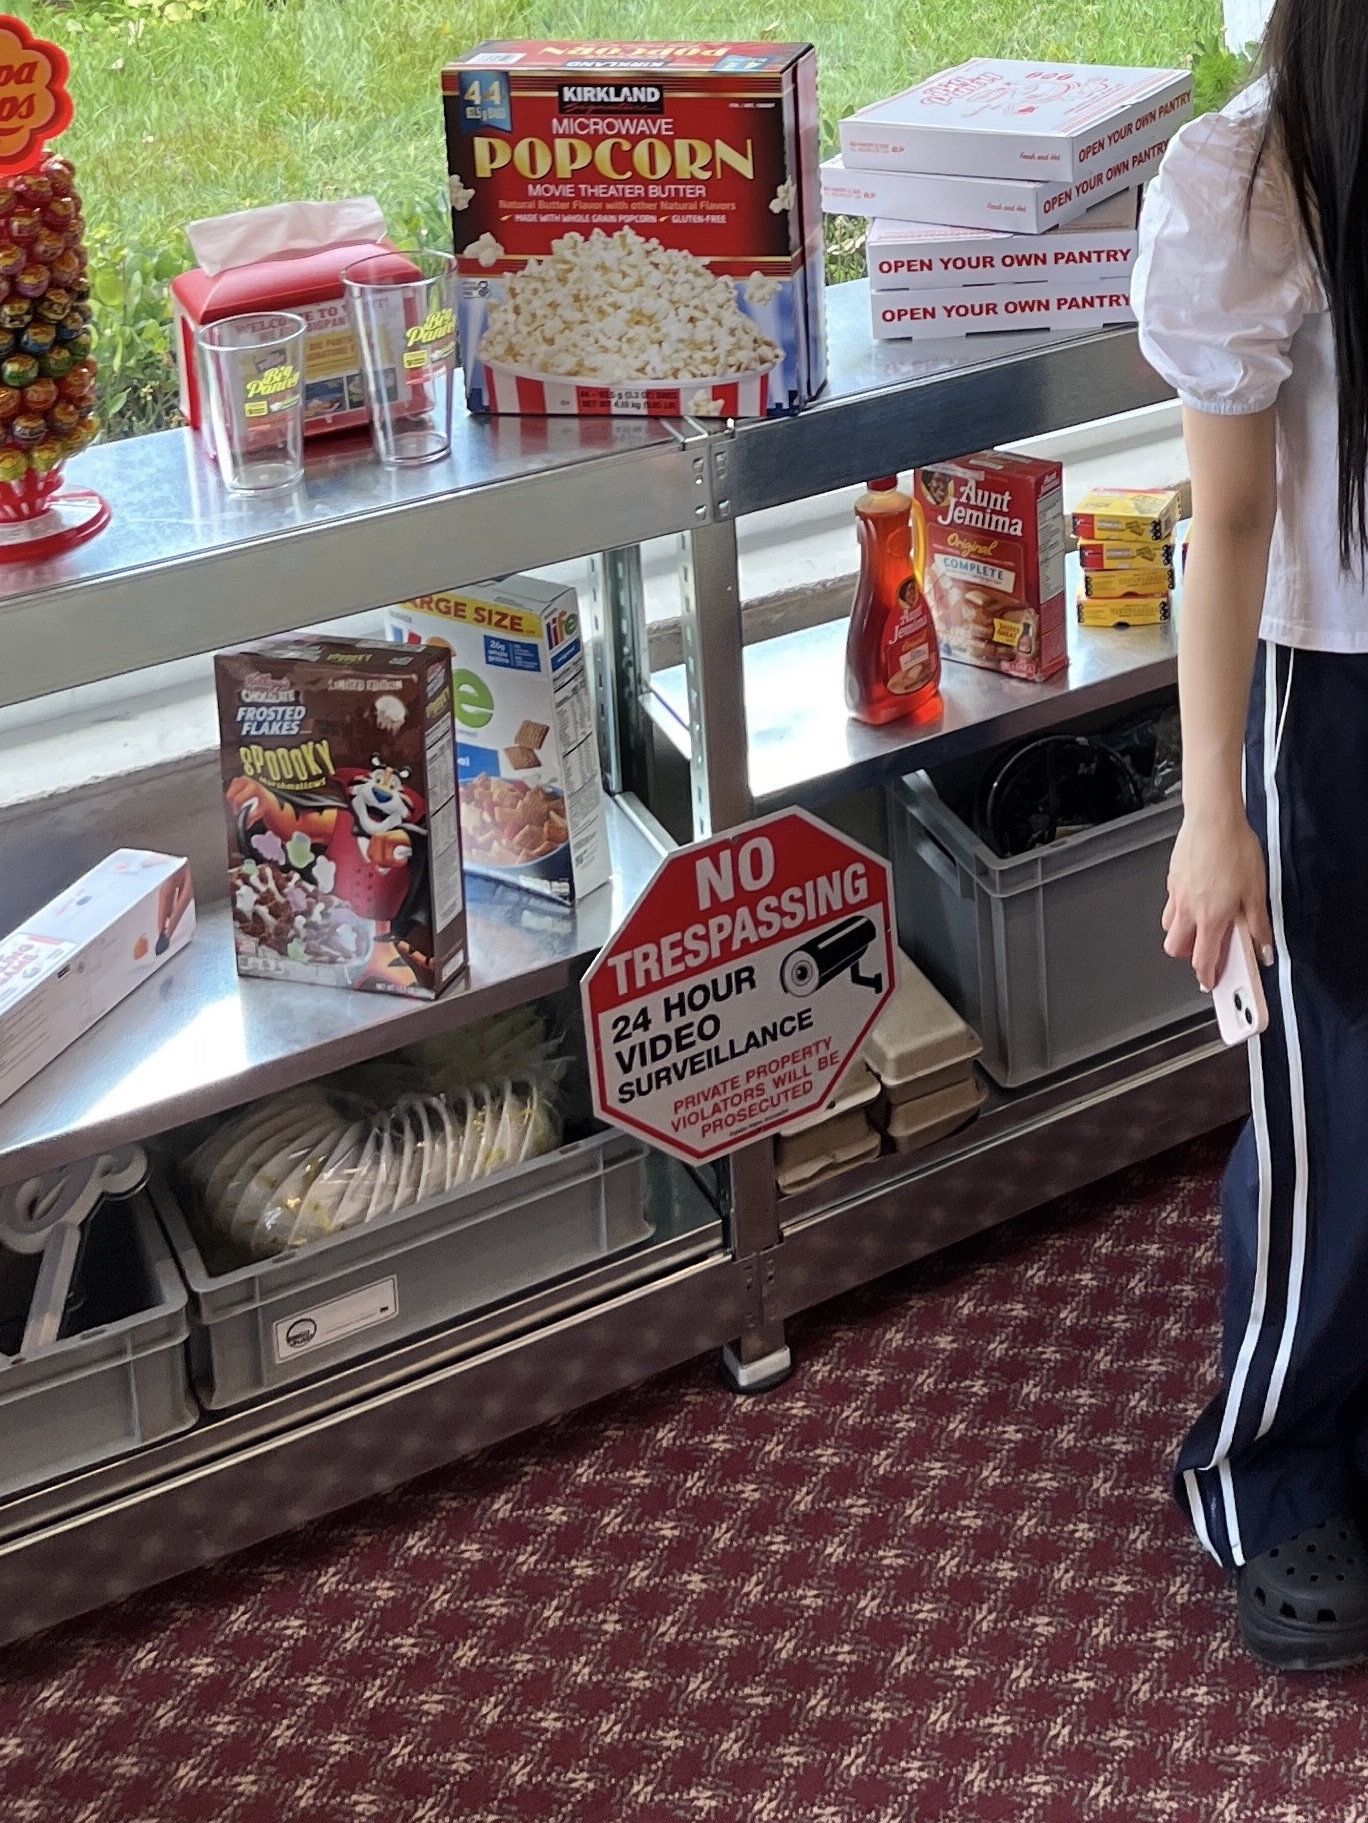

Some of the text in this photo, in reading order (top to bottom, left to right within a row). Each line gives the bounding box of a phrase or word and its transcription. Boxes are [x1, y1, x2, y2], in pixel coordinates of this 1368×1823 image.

[563, 86, 661, 103] KIRKLAND
[552, 118, 674, 136] MICROWAVE
[1078, 89, 1193, 164] OPEN YOUR OWN PANTRY
[474, 136, 754, 181] POPCORN
[527, 184, 706, 198] MOVIE THEATER BUTTER
[1043, 138, 1170, 215] OPEN YOUR OWN PANTRY
[498, 199, 736, 211] Natural Butter Flavor with other Natural Flavors
[539, 213, 560, 223] WITH
[617, 214, 657, 223] POPCORN
[671, 214, 727, 224] GLUTEN-FREE
[878, 248, 1132, 275] OPEN YOUR OWN PANTRY
[318, 306, 338, 319] TO
[423, 307, 453, 329] Big
[881, 293, 1131, 323] OPEN YOUR OWN PANTRY
[262, 365, 294, 385] Big
[959, 479, 1013, 513] Aunt
[937, 496, 1023, 538] Jemima
[947, 532, 999, 558] Original
[943, 557, 1004, 581] COMPLETE
[404, 596, 524, 633] ARGE SIZE
[546, 609, 578, 651] life
[888, 615, 928, 645] Jemima
[241, 689, 296, 703] CHOCOLATE
[236, 705, 306, 722] FROSTED
[241, 720, 301, 736] FLAKES
[695, 836, 775, 912] NO
[607, 862, 869, 996] TRESPASSING
[612, 965, 757, 1044] 24 HOUR
[615, 1014, 721, 1075] VIDEO
[617, 1008, 814, 1104] SURVEILLANCE
[673, 1035, 833, 1115] PRIVATE PROPERTY
[671, 1084, 766, 1133] VIOLATORS
[772, 1064, 812, 1090] WILL
[818, 1051, 841, 1070] BE
[701, 1079, 813, 1138] PROSECUTED
